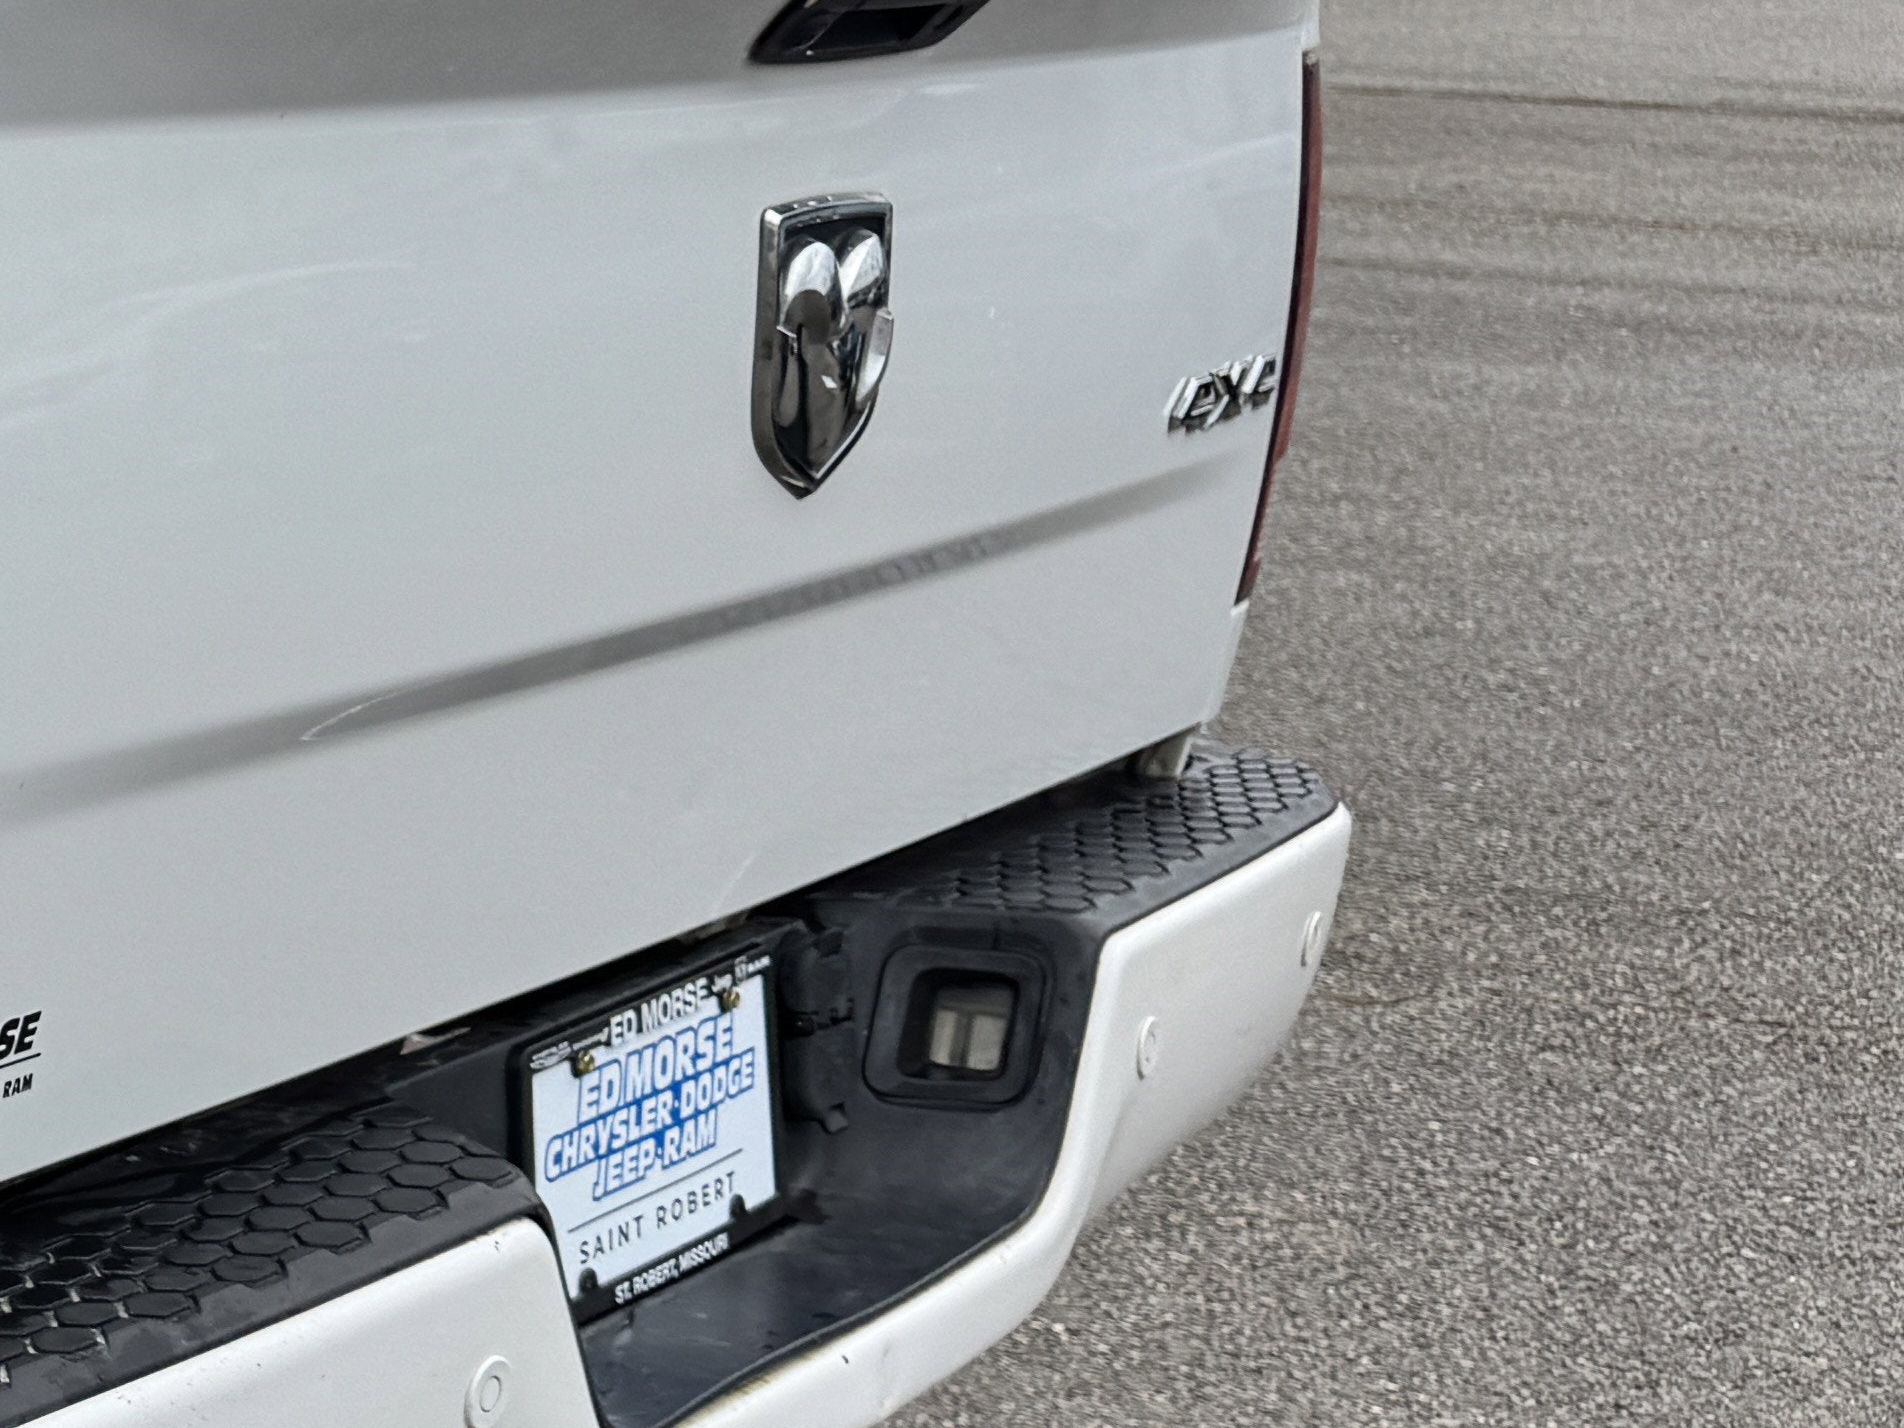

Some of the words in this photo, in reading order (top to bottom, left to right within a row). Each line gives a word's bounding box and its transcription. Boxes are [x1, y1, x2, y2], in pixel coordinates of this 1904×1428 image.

[3, 1073, 33, 1099] RAM
[578, 1058, 622, 1125] ED
[623, 1013, 732, 1105] MORSE
[592, 1134, 656, 1202] JEEP
[661, 1107, 718, 1170] RAM
[579, 1215, 644, 1264] SAINT
[656, 1170, 735, 1229] ROBERT
